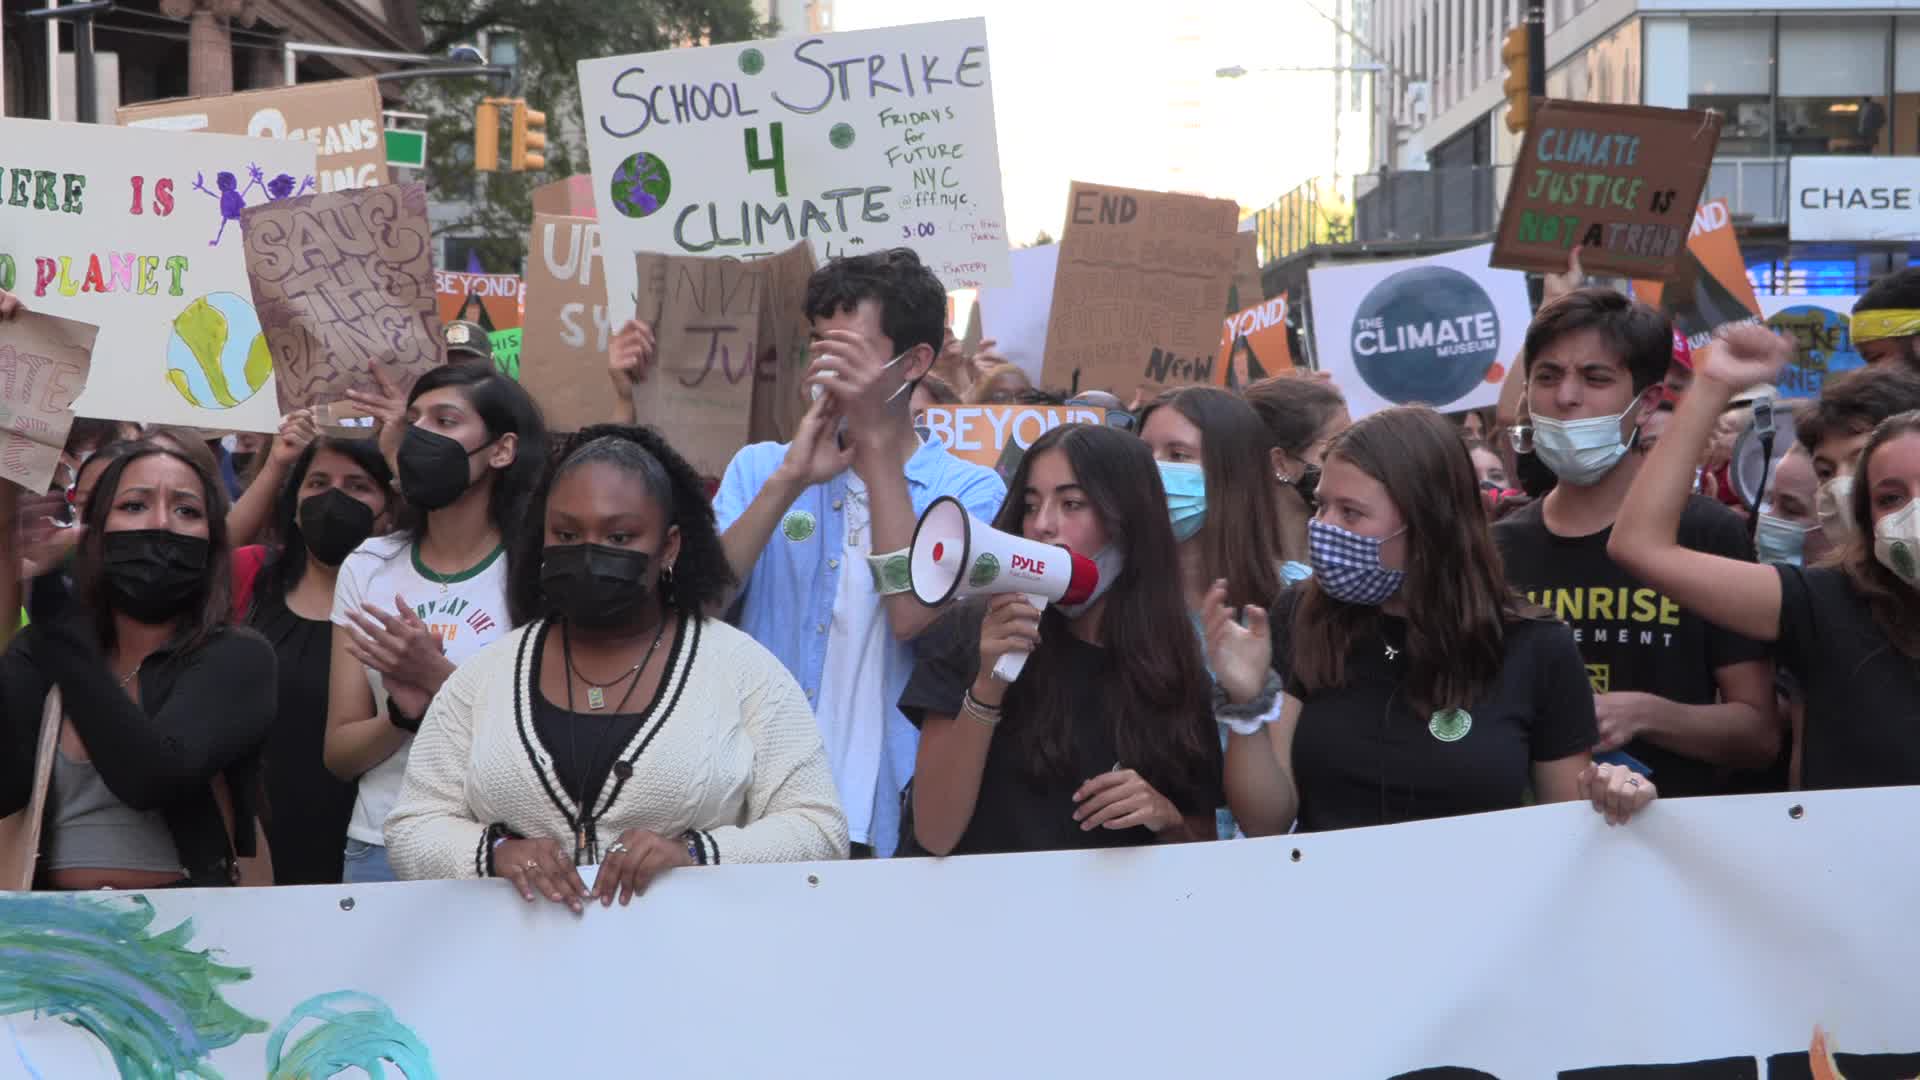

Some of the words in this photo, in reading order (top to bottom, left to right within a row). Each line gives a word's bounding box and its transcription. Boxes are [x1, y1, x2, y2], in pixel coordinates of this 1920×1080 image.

[601, 67, 758, 138] SCHOOL
[771, 39, 985, 113] STRIKE
[878, 106, 955, 128] FRIDAYS
[904, 128, 926, 145] for
[1536, 128, 1641, 167] CLIMATE
[743, 121, 788, 197] 4
[885, 144, 964, 168] FUTURE
[0, 165, 87, 215] ERE
[129, 175, 176, 217] IS
[912, 166, 959, 189] NYC
[1527, 168, 1644, 211] JUSTICE
[1649, 190, 1677, 215] IS
[1071, 190, 1138, 225] END
[1800, 187, 1912, 210] CHASE
[673, 186, 891, 252] CLIMATE
[902, 222, 936, 239] 3:00
[1518, 210, 1580, 249] NOT
[1582, 223, 1603, 248] A
[1606, 222, 1681, 257] TREND
[34, 252, 189, 298] PLANET
[1355, 312, 1495, 356] CLIMATE
[1359, 317, 1384, 330] THE
[1436, 339, 1496, 358] MUSEUM
[1011, 554, 1046, 576] PYLE
